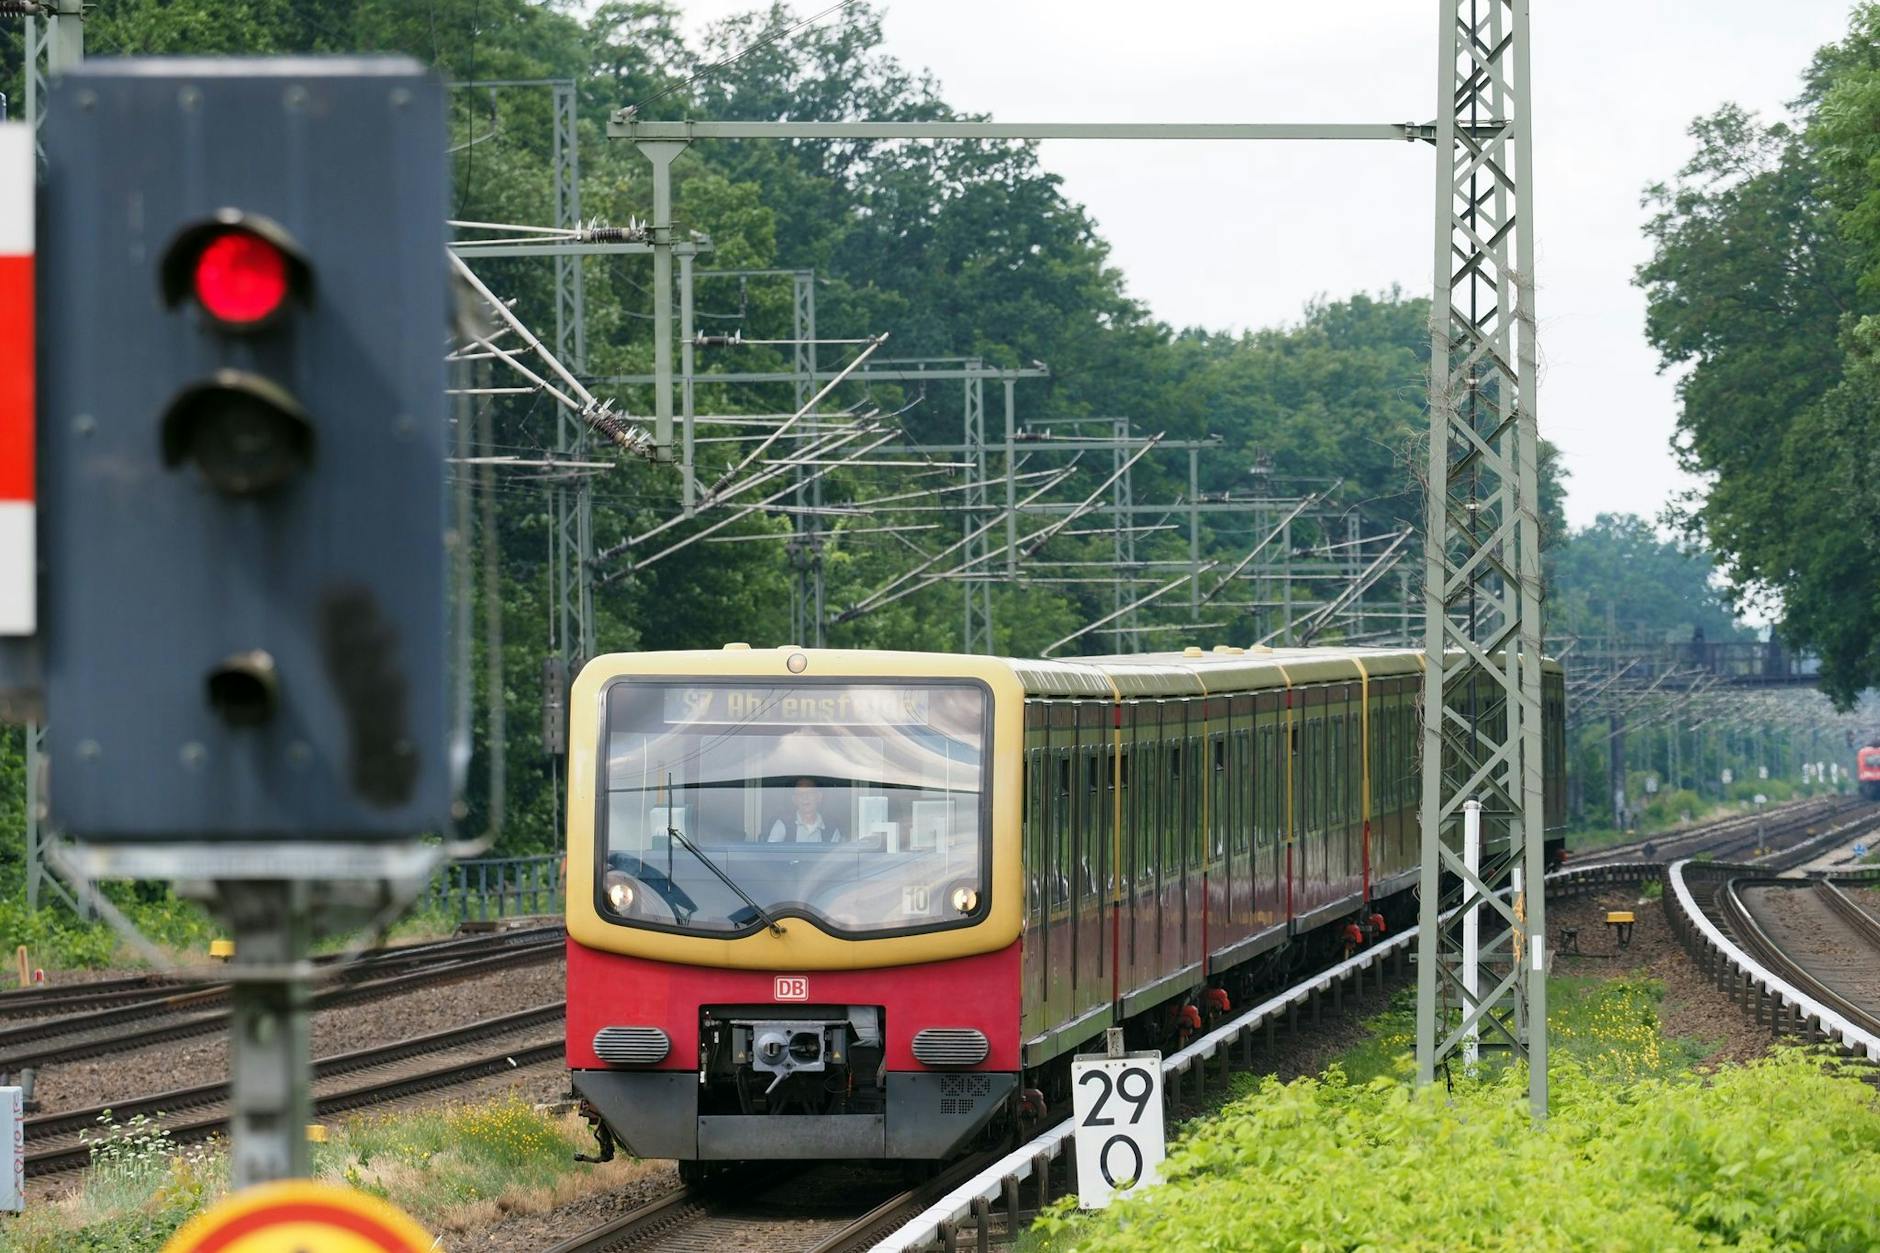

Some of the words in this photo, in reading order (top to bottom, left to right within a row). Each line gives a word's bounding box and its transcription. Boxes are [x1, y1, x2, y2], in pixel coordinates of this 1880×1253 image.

[904, 887, 929, 912] 10
[777, 979, 806, 997] DB
[1078, 1067, 1154, 1127] 29
[1099, 1133, 1144, 1192] 0
